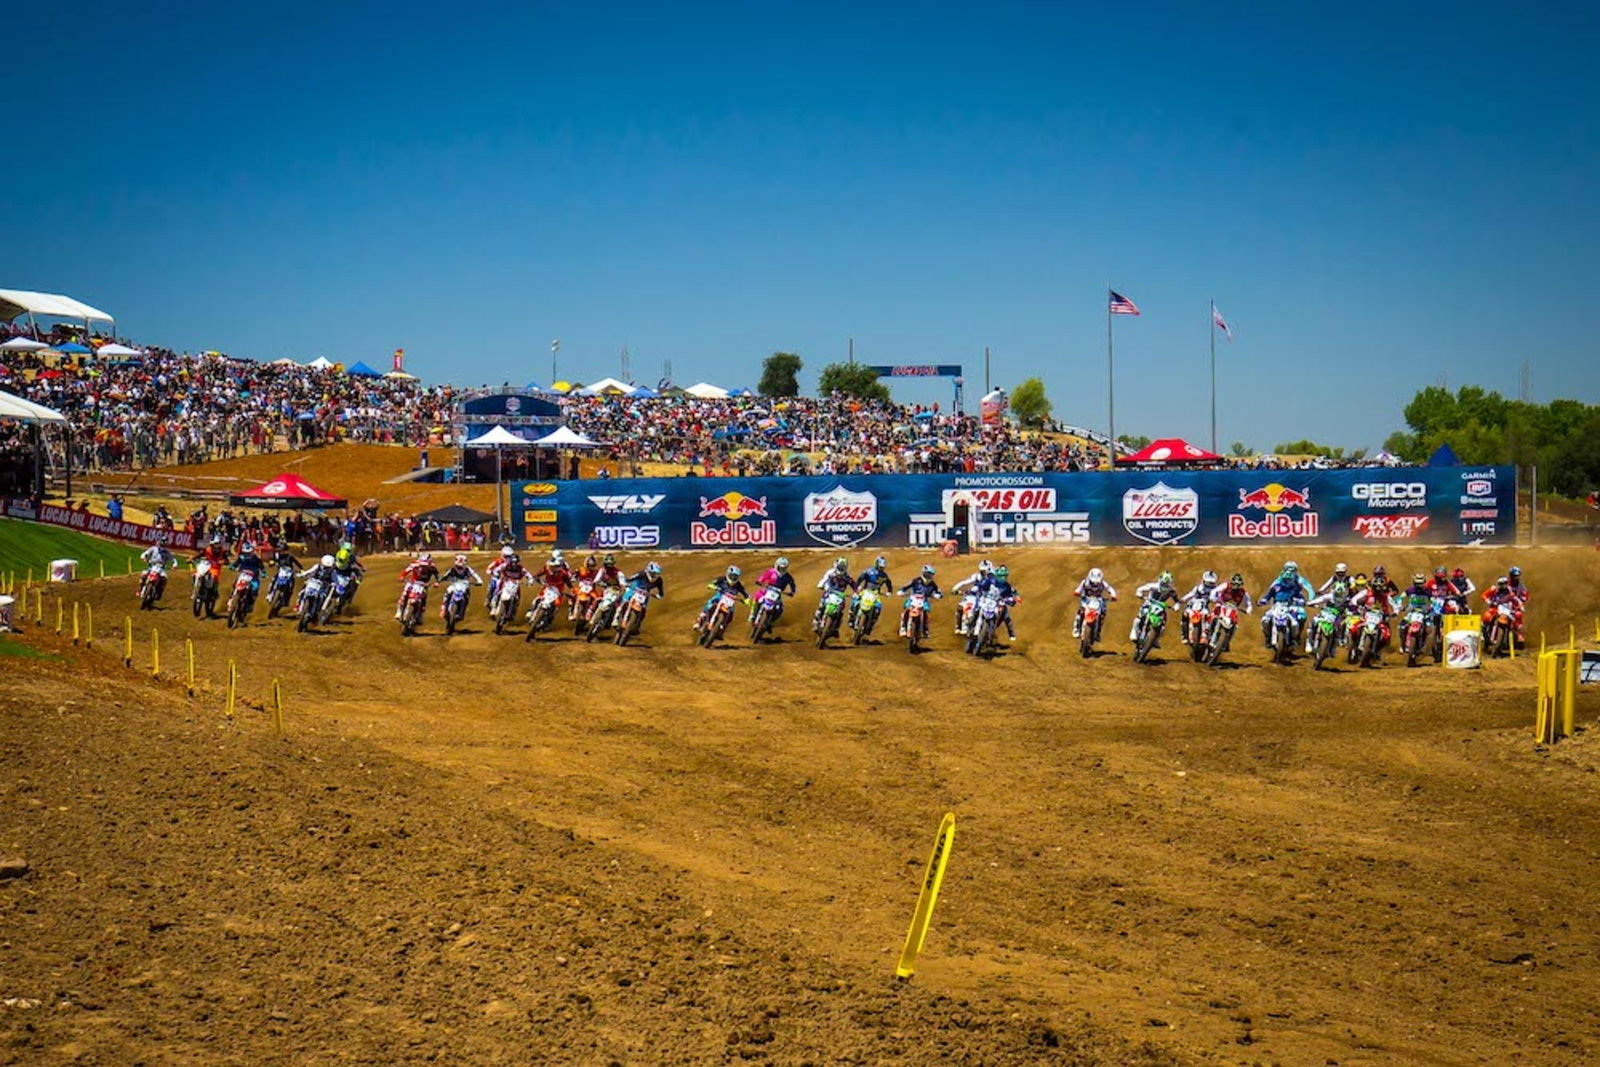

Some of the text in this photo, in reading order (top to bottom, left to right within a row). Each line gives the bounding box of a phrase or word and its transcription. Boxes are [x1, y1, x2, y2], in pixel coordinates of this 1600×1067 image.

[1352, 483, 1426, 499] GEICO
[597, 495, 666, 510] FLY
[952, 490, 1052, 510] CAS OIL
[814, 506, 872, 521] LUCAS
[1133, 503, 1193, 517] LUCAS
[809, 523, 872, 532] OIL PRODUCTS
[1128, 521, 1194, 529] OIL PRODUCTS
[1230, 513, 1318, 537] Red Bull
[595, 526, 660, 547] WPS
[692, 521, 775, 545] Red Bull
[1363, 529, 1414, 539] ALL OUT
